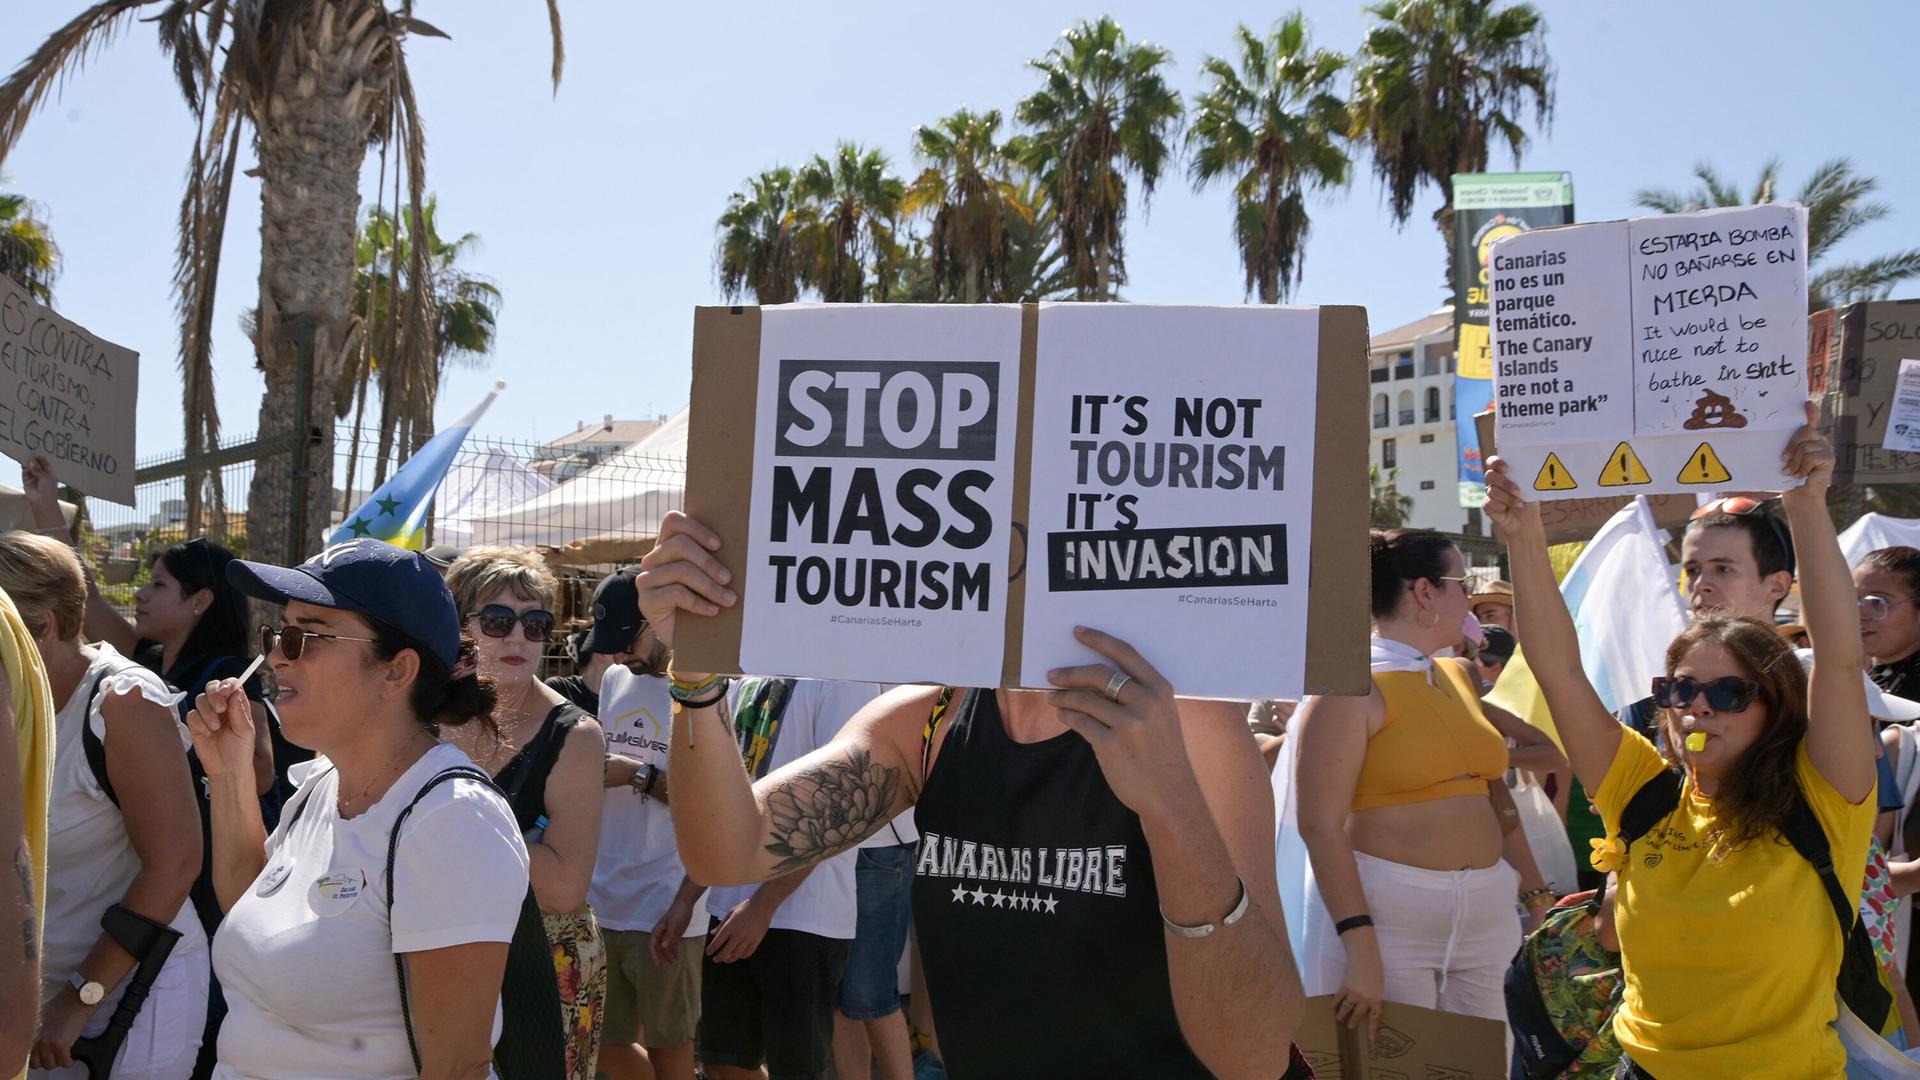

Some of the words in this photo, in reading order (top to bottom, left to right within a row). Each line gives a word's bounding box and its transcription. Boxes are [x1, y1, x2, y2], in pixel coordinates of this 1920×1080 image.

[1640, 231, 1722, 255] ESTARIA
[1729, 225, 1794, 246] BOMBA
[1494, 250, 1567, 272] Canarias
[1642, 263, 1668, 281] NO
[1675, 252, 1757, 277] BAÑARSE
[1766, 248, 1796, 264] EN
[1494, 277, 1516, 292] no
[1520, 275, 1539, 289] es
[1543, 271, 1565, 287] un
[1495, 293, 1555, 315] parque
[1653, 281, 1759, 316] MIERDA
[1, 291, 28, 336] ES
[29, 317, 112, 380] CONTRA
[1495, 312, 1577, 332] temático.
[1644, 326, 1663, 341] It
[1669, 316, 1729, 337] would
[1739, 314, 1767, 331] be
[1497, 339, 1528, 356] The
[1532, 335, 1593, 353] Canary
[1642, 347, 1682, 364] nice
[1694, 335, 1728, 357] not
[1735, 337, 1760, 353] to
[1498, 357, 1559, 377] Islands
[1648, 371, 1707, 392] bathe
[1717, 365, 1741, 382] in
[1499, 382, 1526, 398] are
[1530, 378, 1559, 395] not
[1563, 379, 1574, 393] a
[16, 381, 91, 438] CONTRA
[784, 369, 991, 450] STOP
[1174, 397, 1262, 439] NOT
[1500, 401, 1555, 418] theme
[1070, 440, 1286, 491] TOURISM
[770, 465, 994, 550] MASS
[769, 555, 990, 611] TOURISM
[1178, 594, 1278, 608] #CanariasSeHarta
[830, 614, 922, 627] #CanariasSeHarta
[1037, 845, 1127, 898] LIBRE
